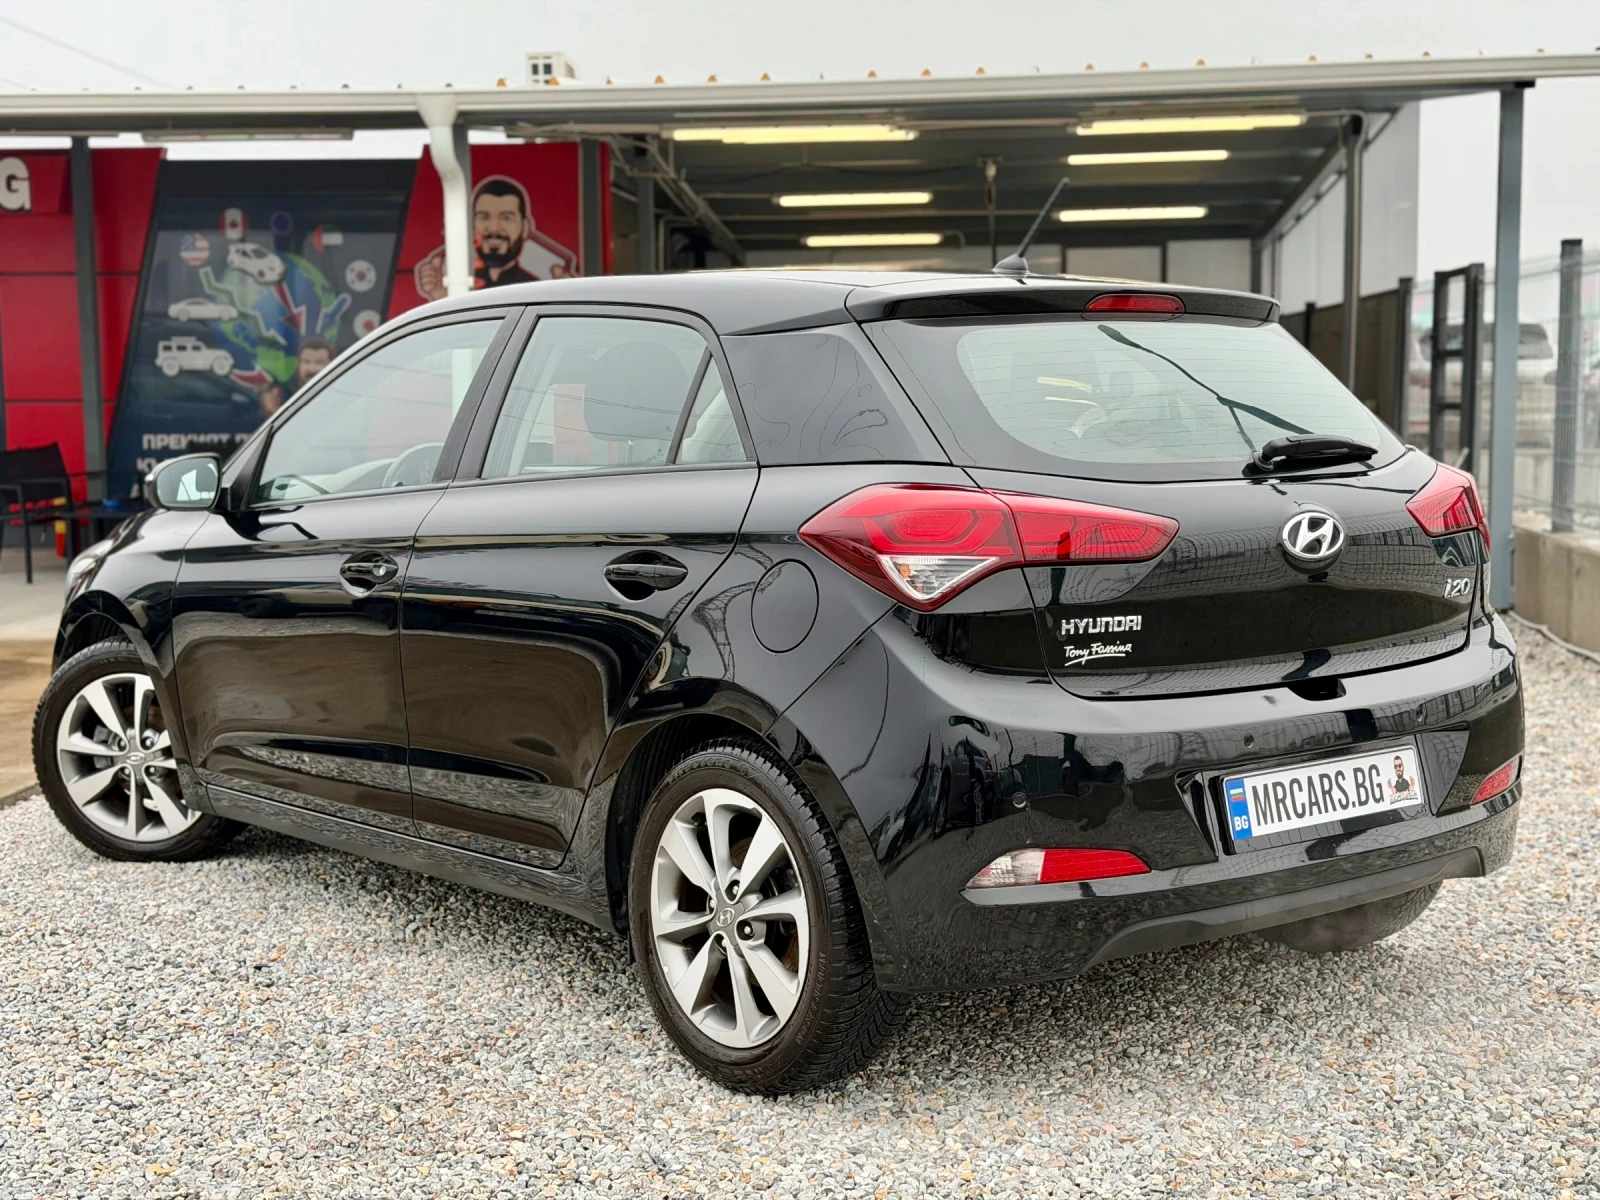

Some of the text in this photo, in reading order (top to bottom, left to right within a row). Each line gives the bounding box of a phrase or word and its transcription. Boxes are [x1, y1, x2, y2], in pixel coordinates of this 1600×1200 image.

[1444, 578, 1470, 598] i20
[1061, 615, 1142, 635] HYUNDAI
[1064, 641, 1132, 665] Tony Fassina
[1251, 763, 1385, 827] MRCARS.BG
[1233, 816, 1249, 831] BG
